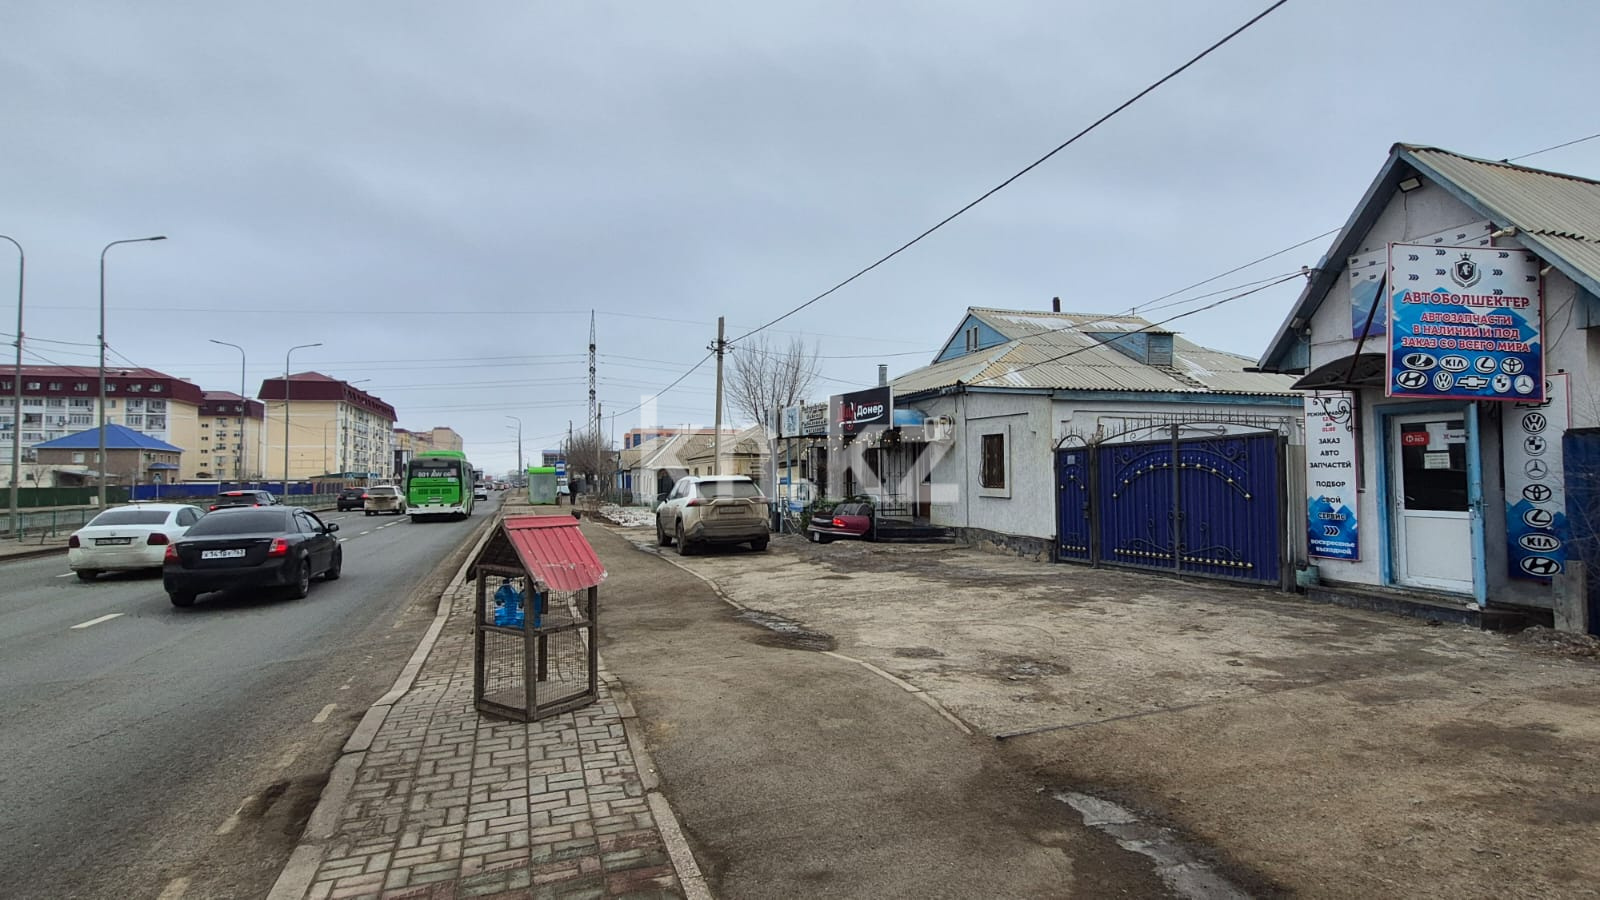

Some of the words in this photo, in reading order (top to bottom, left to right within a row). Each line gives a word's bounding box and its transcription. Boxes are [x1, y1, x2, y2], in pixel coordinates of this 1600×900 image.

[1402, 291, 1531, 308] АВТОБОЛШЕКТЕР
[1420, 312, 1513, 325] АВТОЗАПЧАСТИ
[1412, 325, 1420, 333] В
[1423, 325, 1480, 337] НАЛИЧИИ
[1483, 328, 1491, 337] И
[1494, 328, 1520, 340] ПОД
[1402, 337, 1436, 347] ЗАКАЗ
[1439, 339, 1458, 348] СО
[1459, 340, 1495, 350] ВСЕГО
[1498, 342, 1531, 353] МИРА
[1444, 359, 1464, 368] KIA
[857, 404, 884, 417] Донер
[1318, 512, 1346, 520] СЕРВИС
[1526, 537, 1553, 548] KIA
